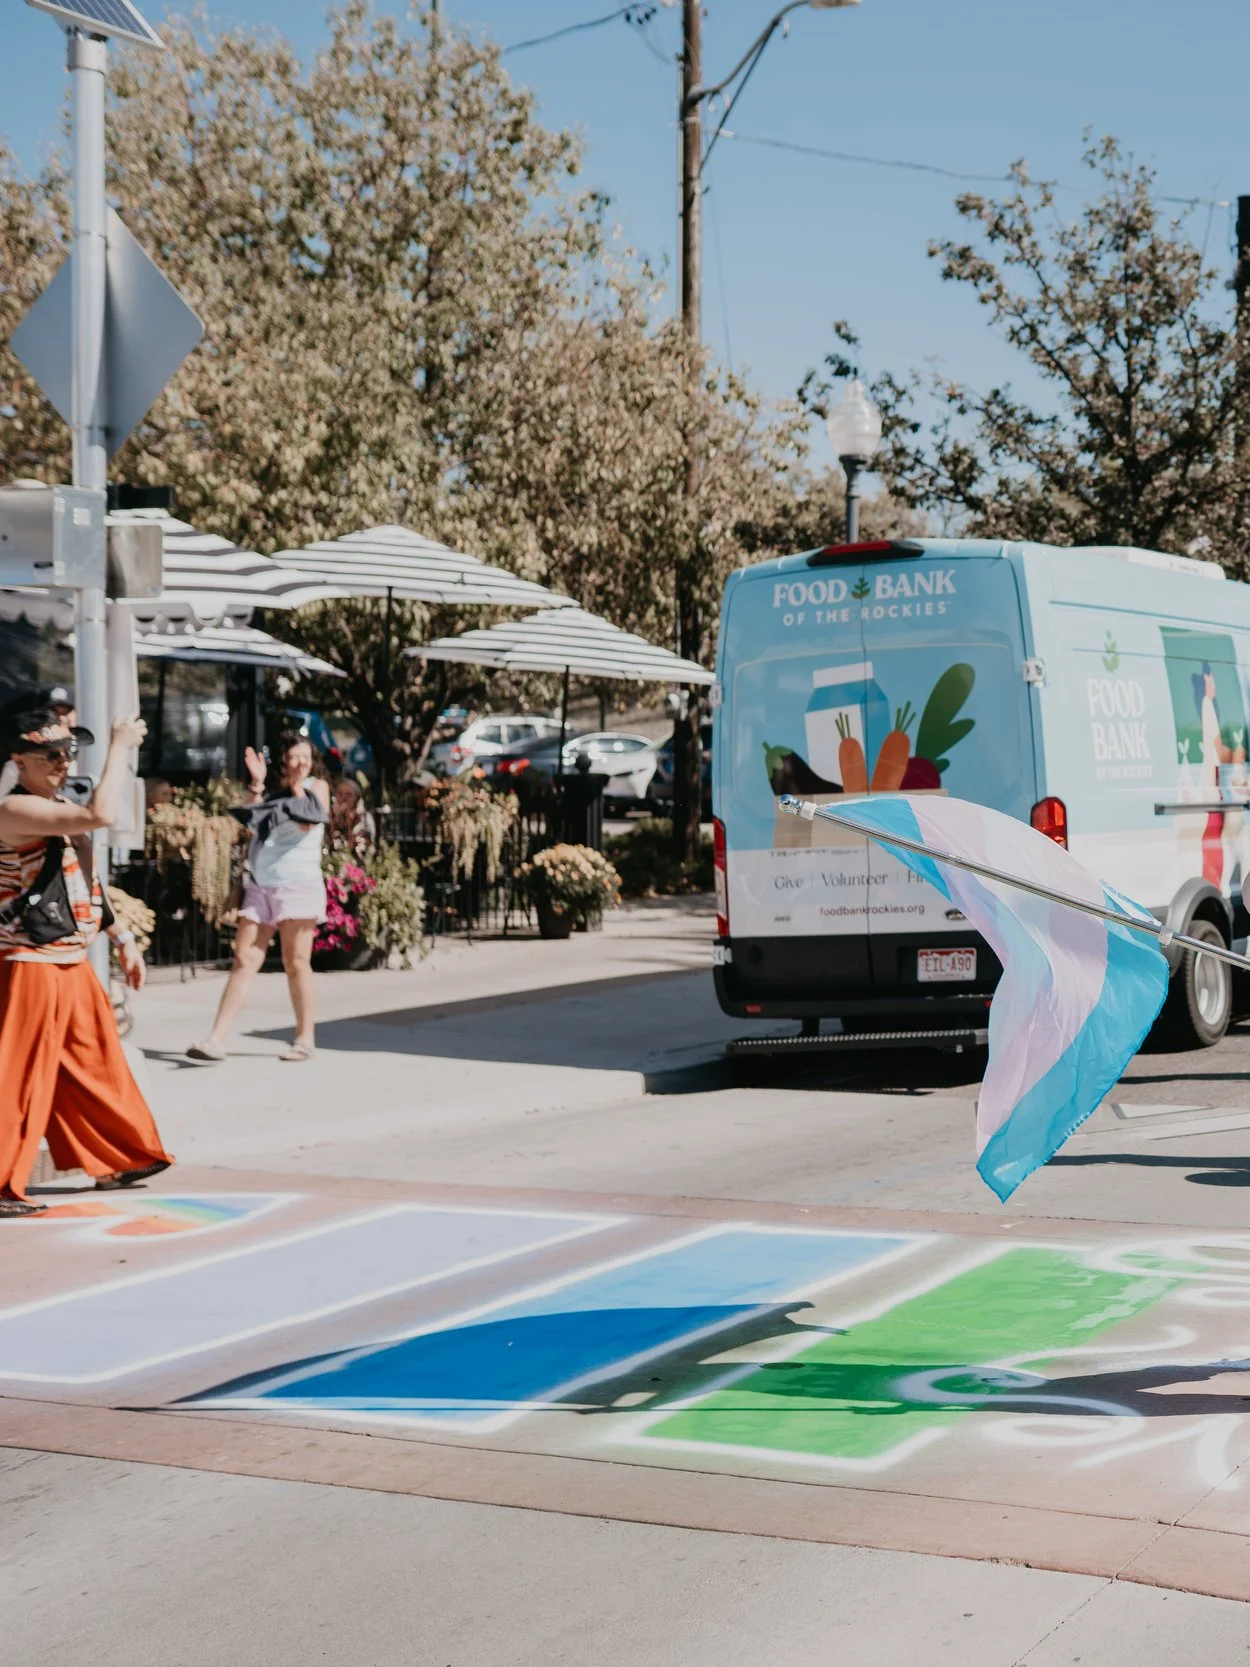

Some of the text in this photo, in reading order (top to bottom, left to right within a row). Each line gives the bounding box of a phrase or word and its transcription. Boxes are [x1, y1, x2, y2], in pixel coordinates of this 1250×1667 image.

[773, 569, 957, 608] FOOD BANK
[783, 602, 947, 627] OF THE ROCKIES
[1085, 678, 1146, 717] FOOD
[1091, 722, 1151, 761] BANK
[774, 875, 804, 890] Give
[821, 872, 889, 888] Volunteer
[820, 904, 925, 918] foodbankrockies.org
